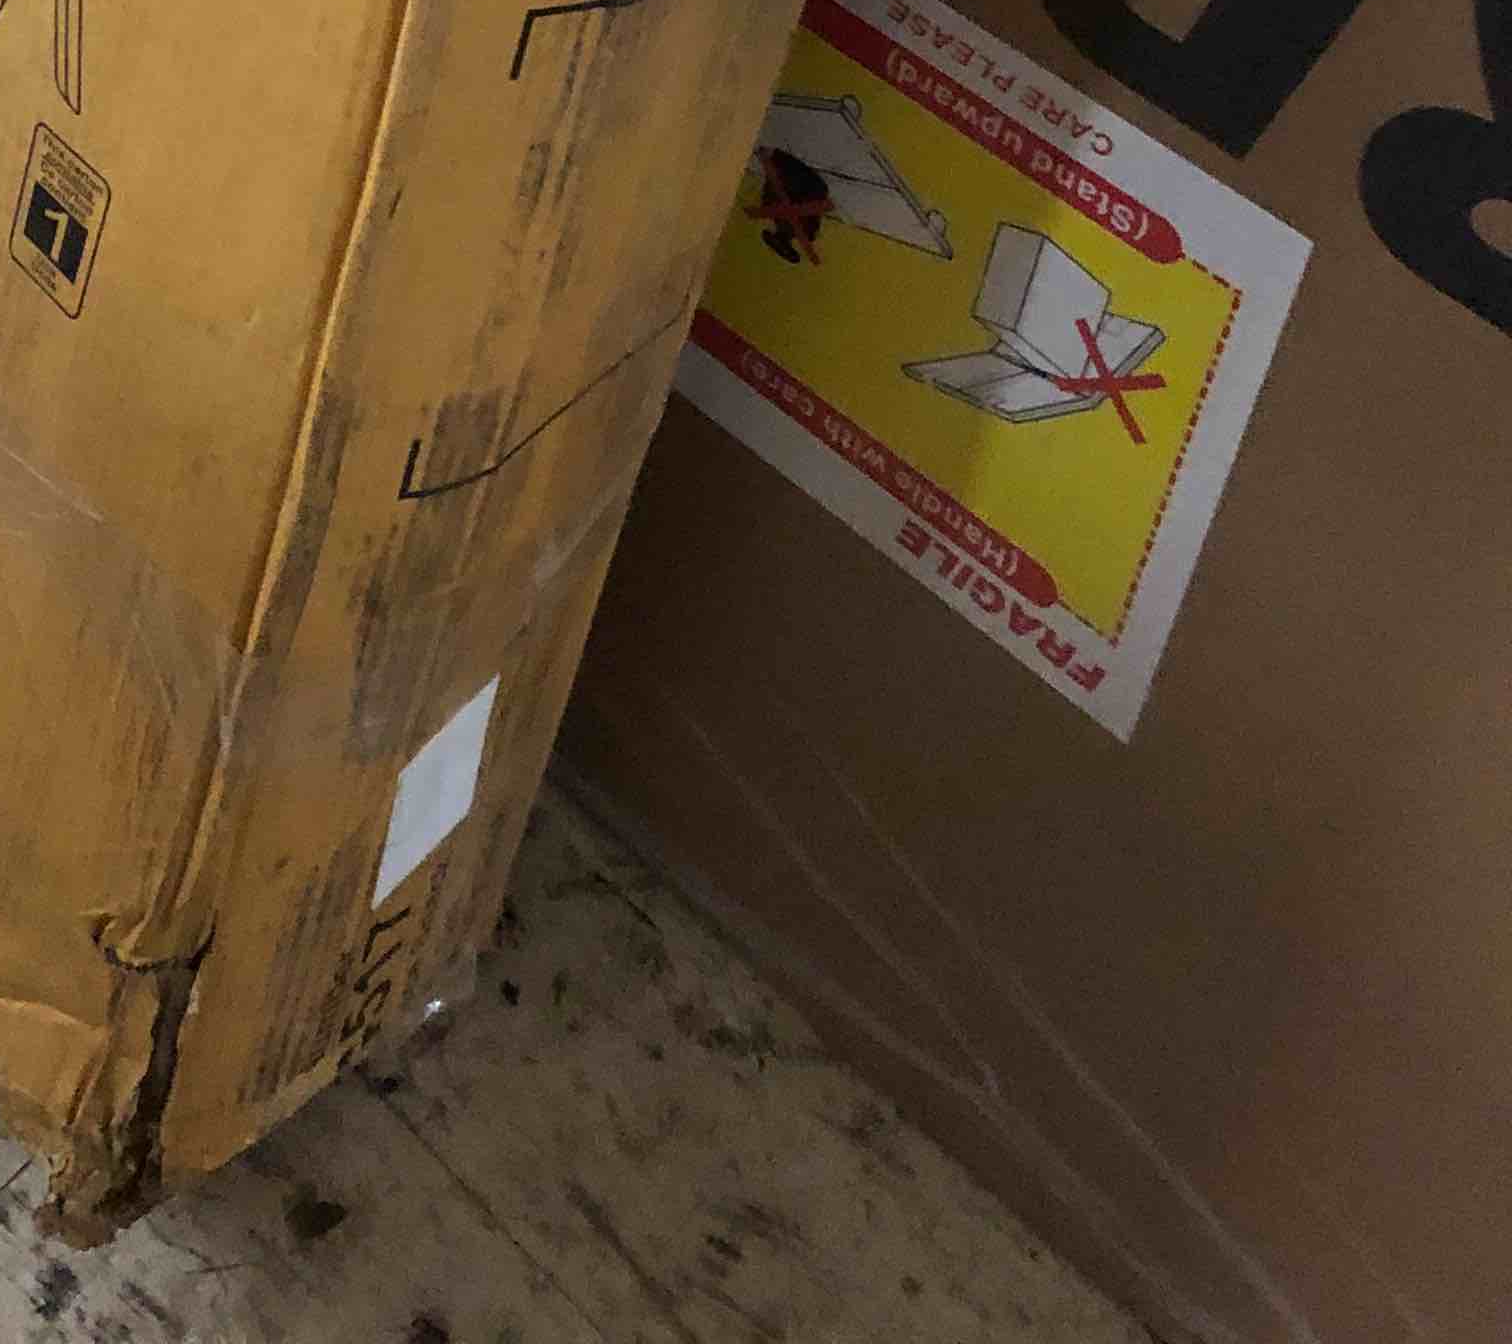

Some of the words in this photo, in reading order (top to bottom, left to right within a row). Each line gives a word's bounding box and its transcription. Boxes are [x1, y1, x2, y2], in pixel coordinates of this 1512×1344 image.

[886, 3, 1018, 94] PLEASE
[886, 43, 1025, 154] upward)
[1018, 85, 1114, 157] CARE
[43, 207, 69, 264] 1
[1032, 150, 1151, 241] (Stand
[824, 413, 888, 475] with
[891, 469, 1023, 580] (Handle
[895, 518, 1108, 693] FRAGILE
